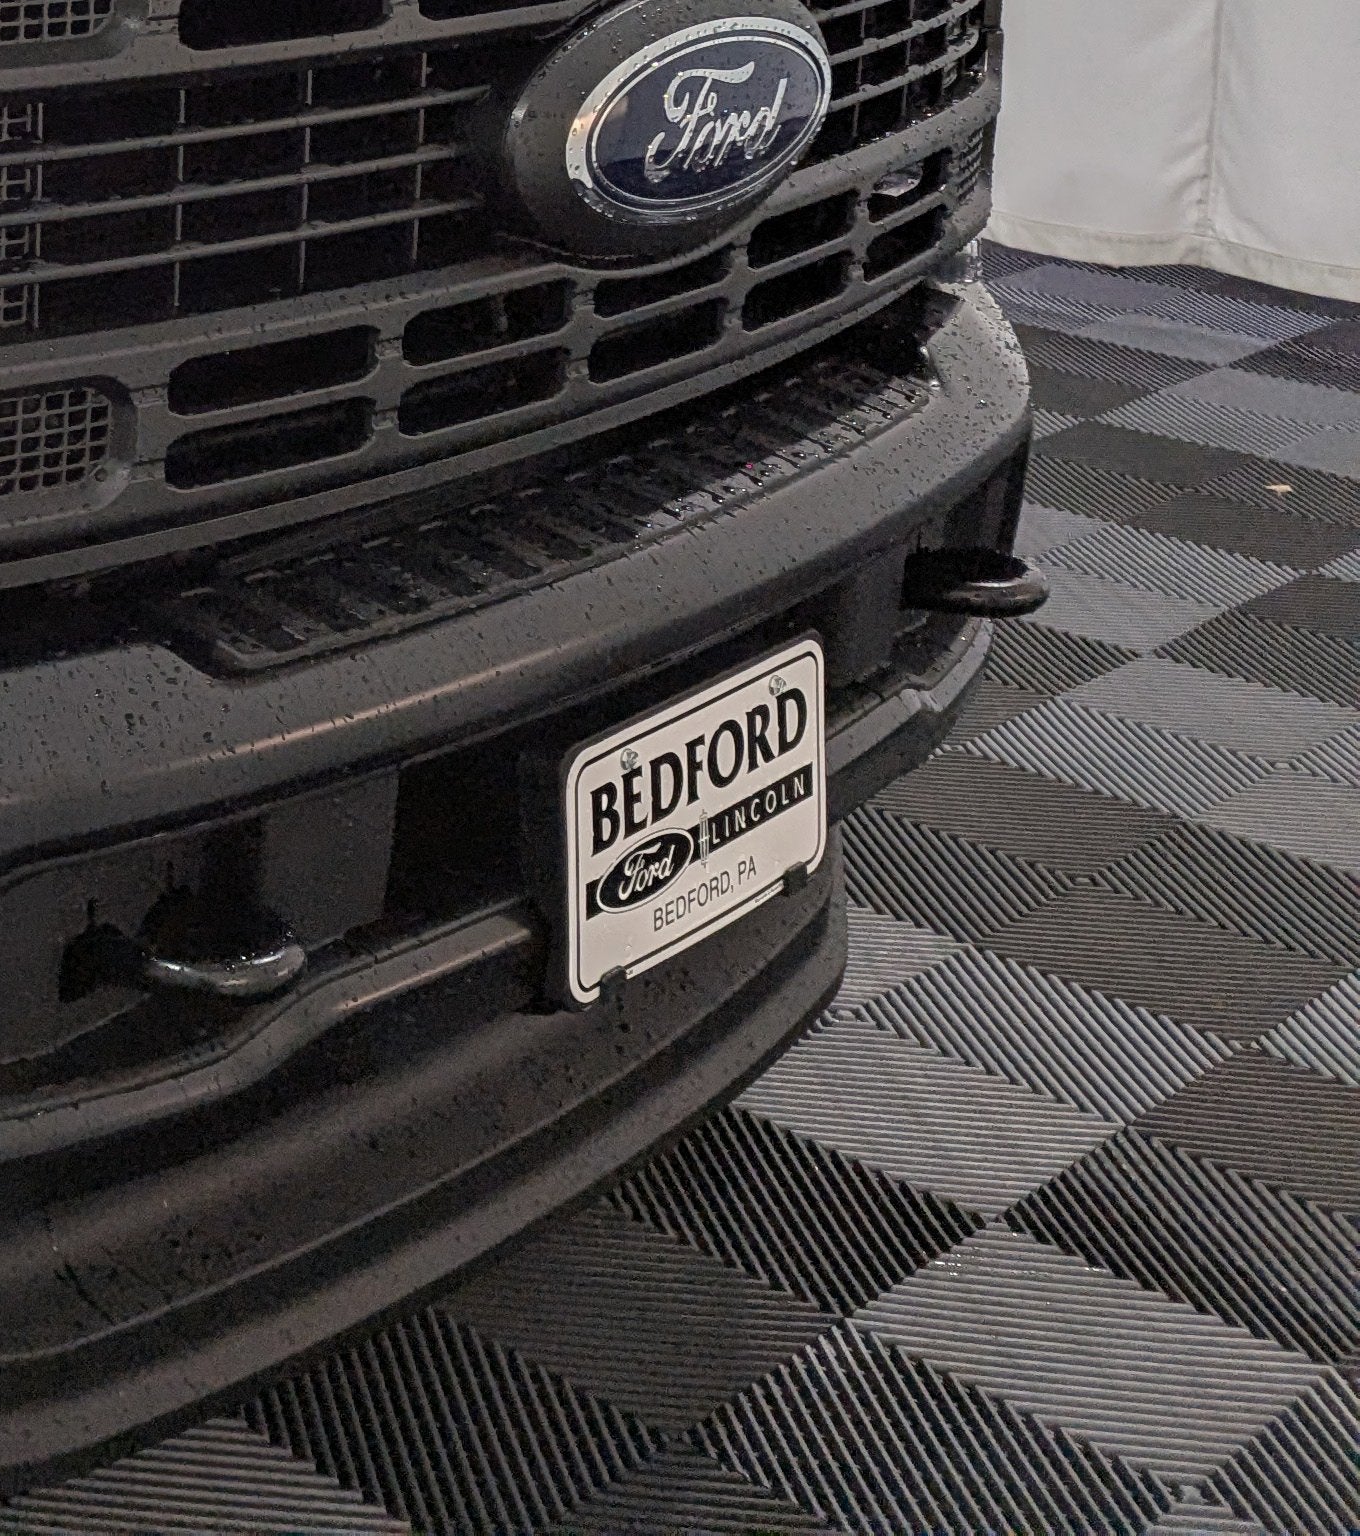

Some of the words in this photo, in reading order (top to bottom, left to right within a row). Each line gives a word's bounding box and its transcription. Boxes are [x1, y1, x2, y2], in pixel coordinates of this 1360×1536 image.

[643, 61, 788, 184] Ford
[591, 688, 807, 857] BEDFORD
[619, 841, 675, 901] Ford
[708, 773, 805, 846] LINCOLN
[653, 870, 734, 932] BEDFORD,
[737, 855, 757, 885] PA
